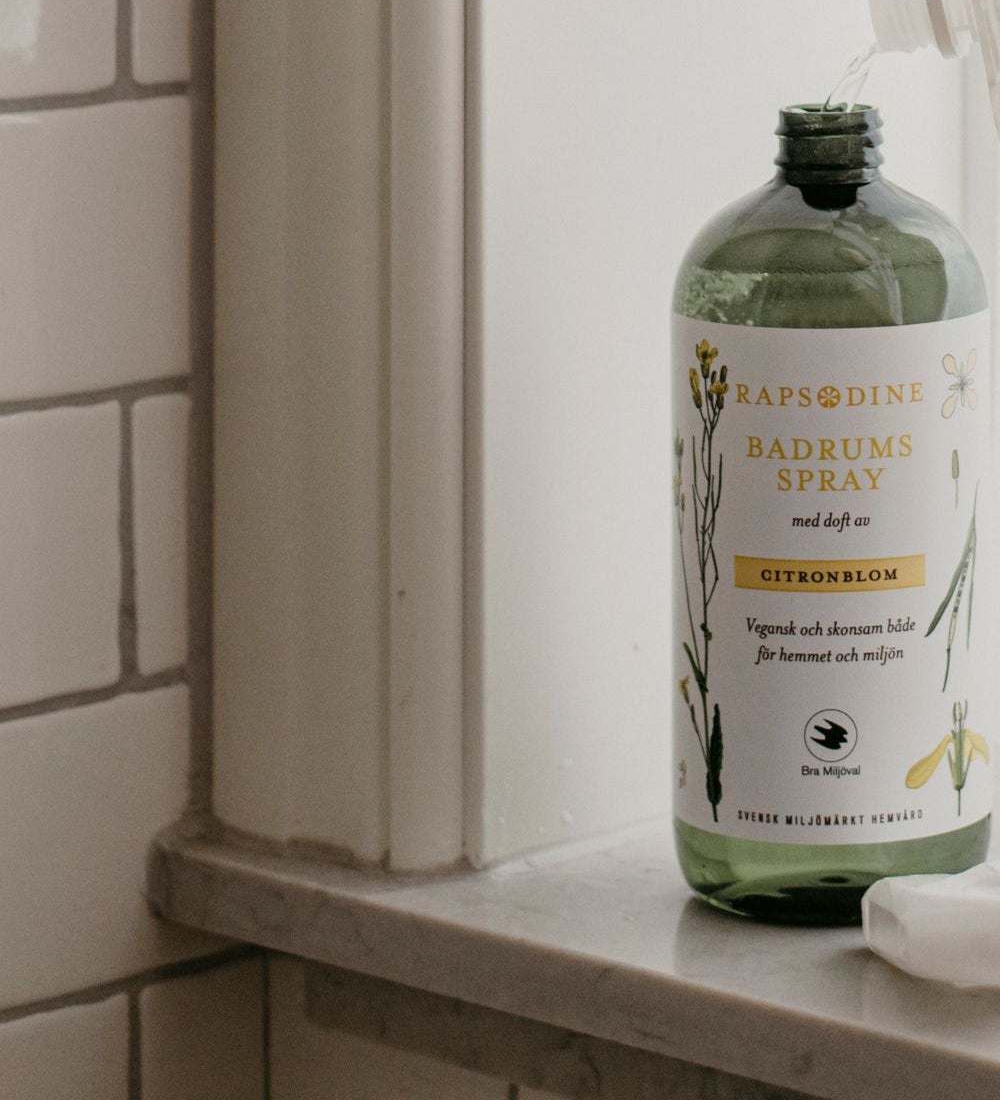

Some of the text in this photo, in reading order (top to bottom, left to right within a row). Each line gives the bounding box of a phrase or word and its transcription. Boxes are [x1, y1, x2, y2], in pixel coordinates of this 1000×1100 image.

[736, 382, 924, 409] RAPSODINE
[746, 434, 913, 460] BADRUMS
[777, 467, 885, 491] SPRAY
[792, 511, 870, 532] med doft av
[760, 568, 898, 583] CITRONBLOM
[746, 617, 916, 639] Vegansk och skonsam både
[754, 645, 904, 665] för hemmet och miljön
[801, 765, 861, 778] Bra Miljöval
[738, 808, 923, 826] SVENSK MILJÖMÄRKT HEMVÅRD
